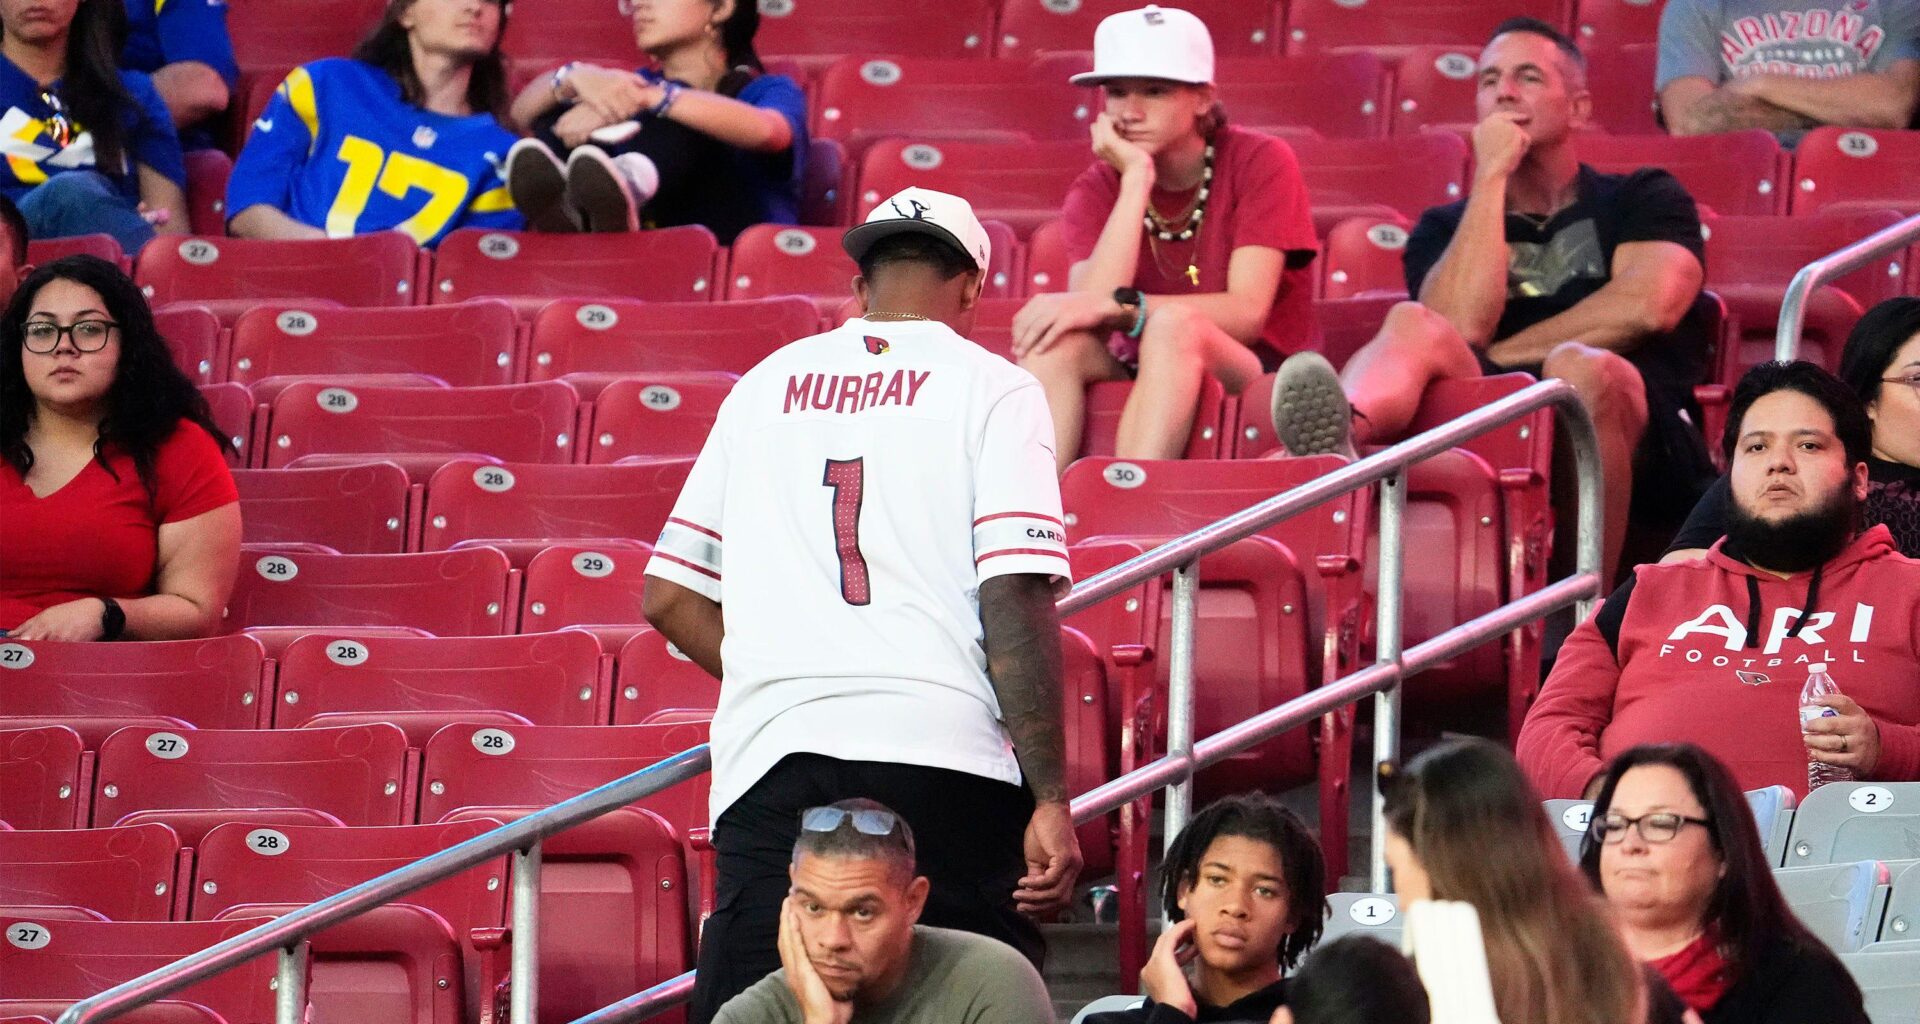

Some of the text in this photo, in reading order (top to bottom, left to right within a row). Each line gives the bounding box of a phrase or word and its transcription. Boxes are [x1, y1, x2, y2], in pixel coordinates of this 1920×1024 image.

[1720, 9, 1885, 67] ARIZONA
[325, 134, 469, 246] 17
[189, 245, 208, 257] 27
[287, 316, 306, 329] 28
[586, 310, 606, 322] 29
[650, 391, 670, 404] 29
[783, 370, 931, 414] MURRAY
[327, 394, 347, 406] 28
[484, 472, 504, 485] 28
[1114, 469, 1136, 481] 30
[822, 456, 871, 606] 1
[1026, 528, 1065, 542] CARD
[266, 562, 287, 575] 28
[583, 558, 603, 571] 29
[1667, 602, 1874, 654] ARI
[3, 649, 24, 662] 27
[337, 646, 358, 659] 28
[1659, 644, 1865, 668] FOOTBALL
[157, 739, 177, 752] 27
[483, 735, 504, 748] 28
[1865, 793, 1877, 806] 2
[1579, 811, 1590, 824] 1
[257, 835, 279, 848] 28
[1366, 905, 1377, 918] 1
[18, 928, 39, 942] 27
